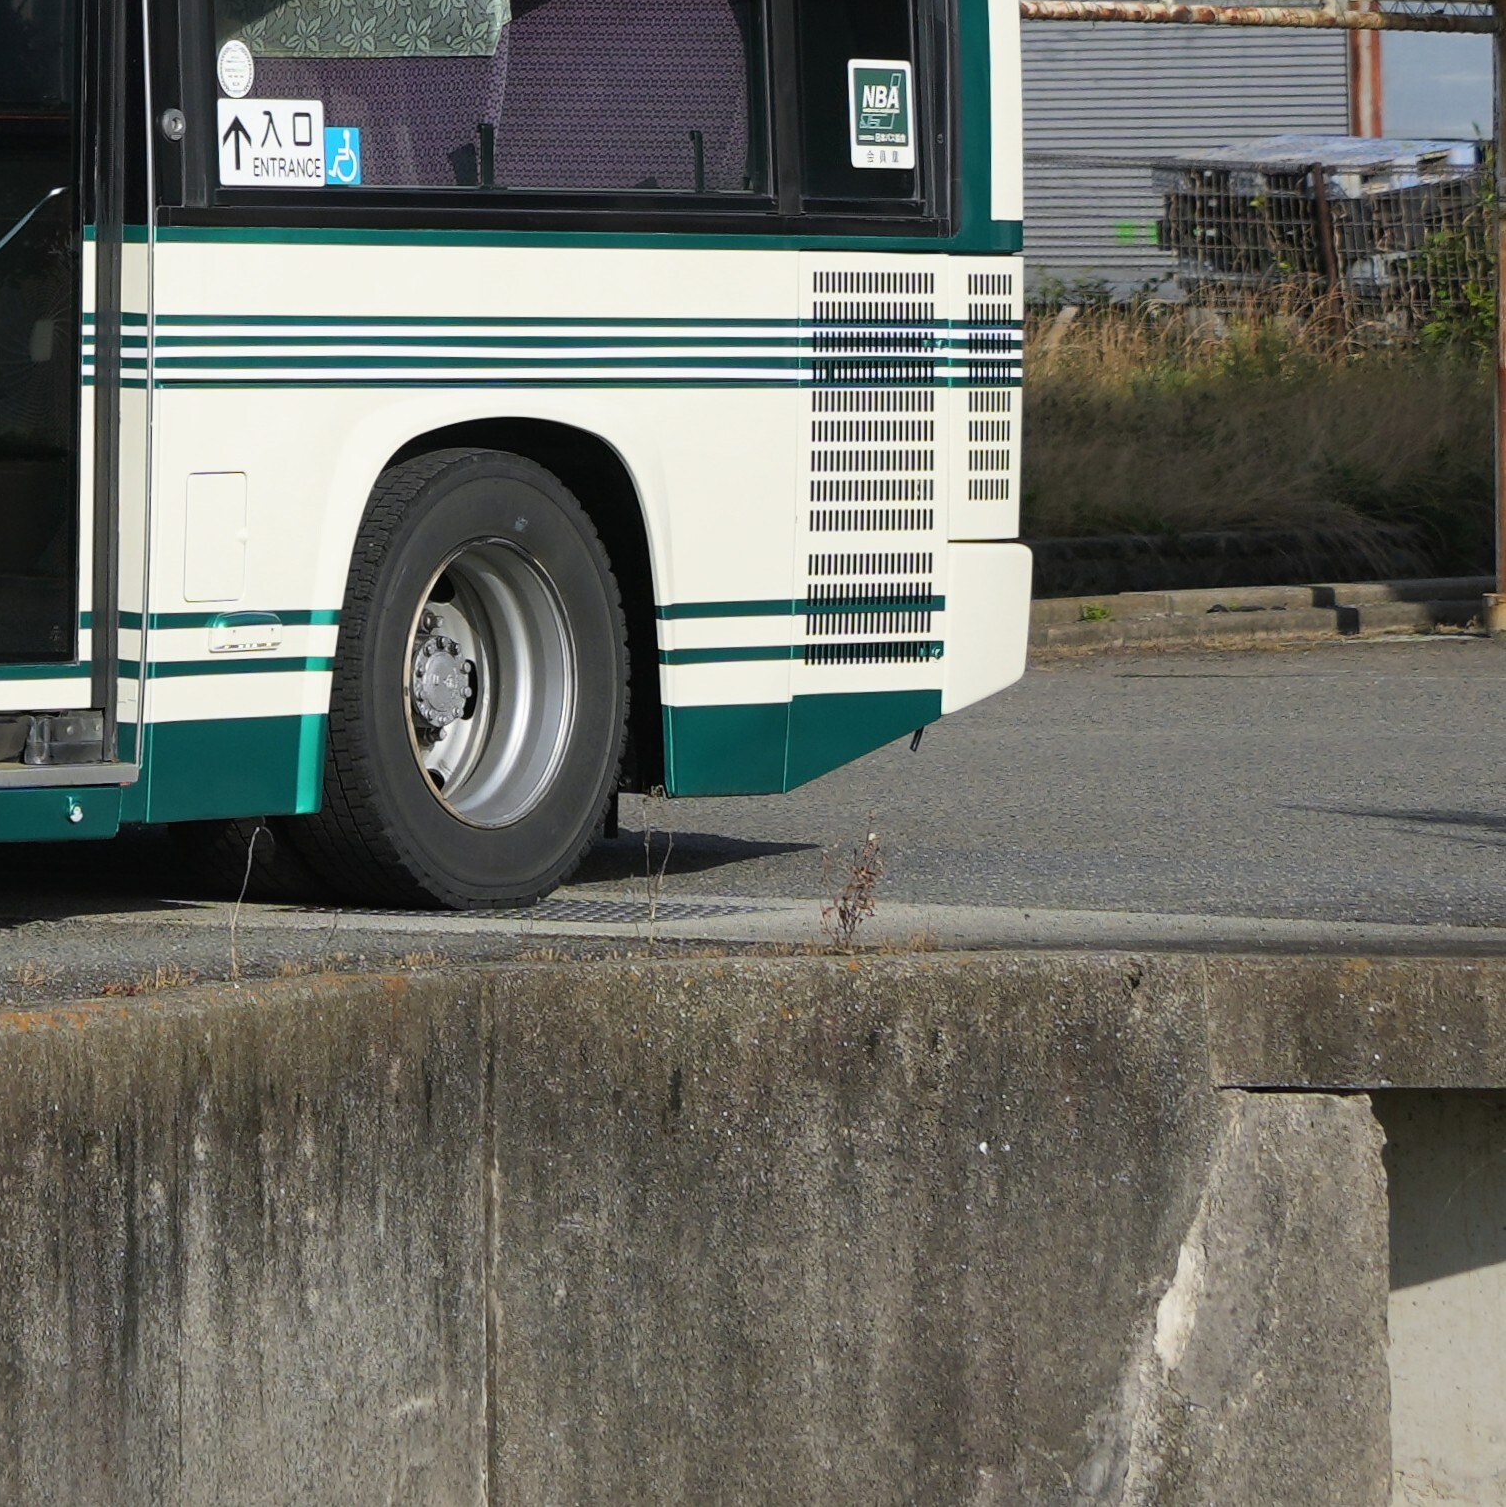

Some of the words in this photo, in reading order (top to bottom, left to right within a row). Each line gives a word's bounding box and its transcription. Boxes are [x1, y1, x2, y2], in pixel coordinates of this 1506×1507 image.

[862, 84, 900, 109] NBA
[260, 110, 313, 149] 入口
[253, 157, 322, 178] ENTRANCE
